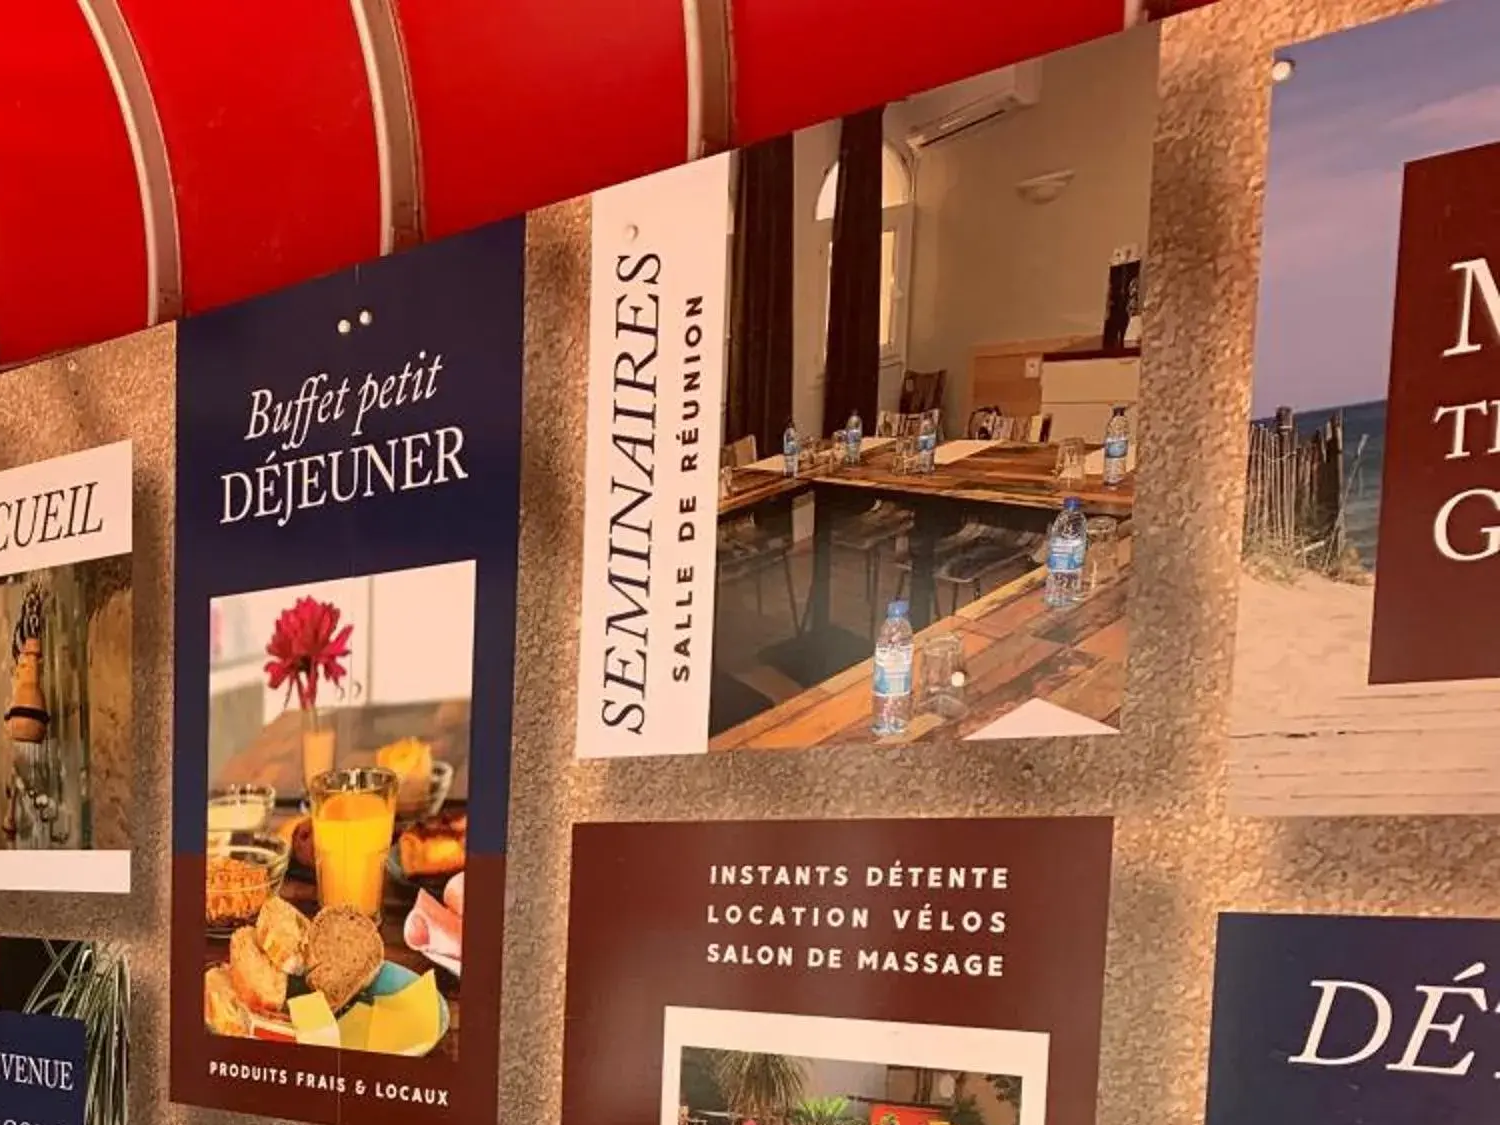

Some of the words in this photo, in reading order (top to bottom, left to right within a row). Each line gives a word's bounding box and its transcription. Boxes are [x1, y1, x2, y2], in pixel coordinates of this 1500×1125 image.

[244, 373, 350, 450] Buffet
[351, 350, 443, 437] petit
[674, 296, 704, 471] RÉUNION
[220, 426, 468, 527] DÉJEUNER
[601, 251, 661, 735] SEMINAIRES
[677, 496, 697, 542] DE
[672, 566, 695, 682] SALLE
[707, 905, 868, 928] LOCATION
[893, 903, 1005, 933] VÉLOS
[710, 865, 849, 886] INSTANTS
[866, 860, 1008, 889] DÉTENTE
[707, 944, 793, 966] SALON
[807, 948, 842, 968] DE
[857, 950, 1003, 977] MASSAGE
[1288, 962, 1500, 1079] DÉ
[209, 1061, 288, 1085] PRODUITS
[296, 1071, 345, 1093] FRAIS
[355, 1079, 367, 1095] &
[375, 1082, 449, 1106] LOCAUX
